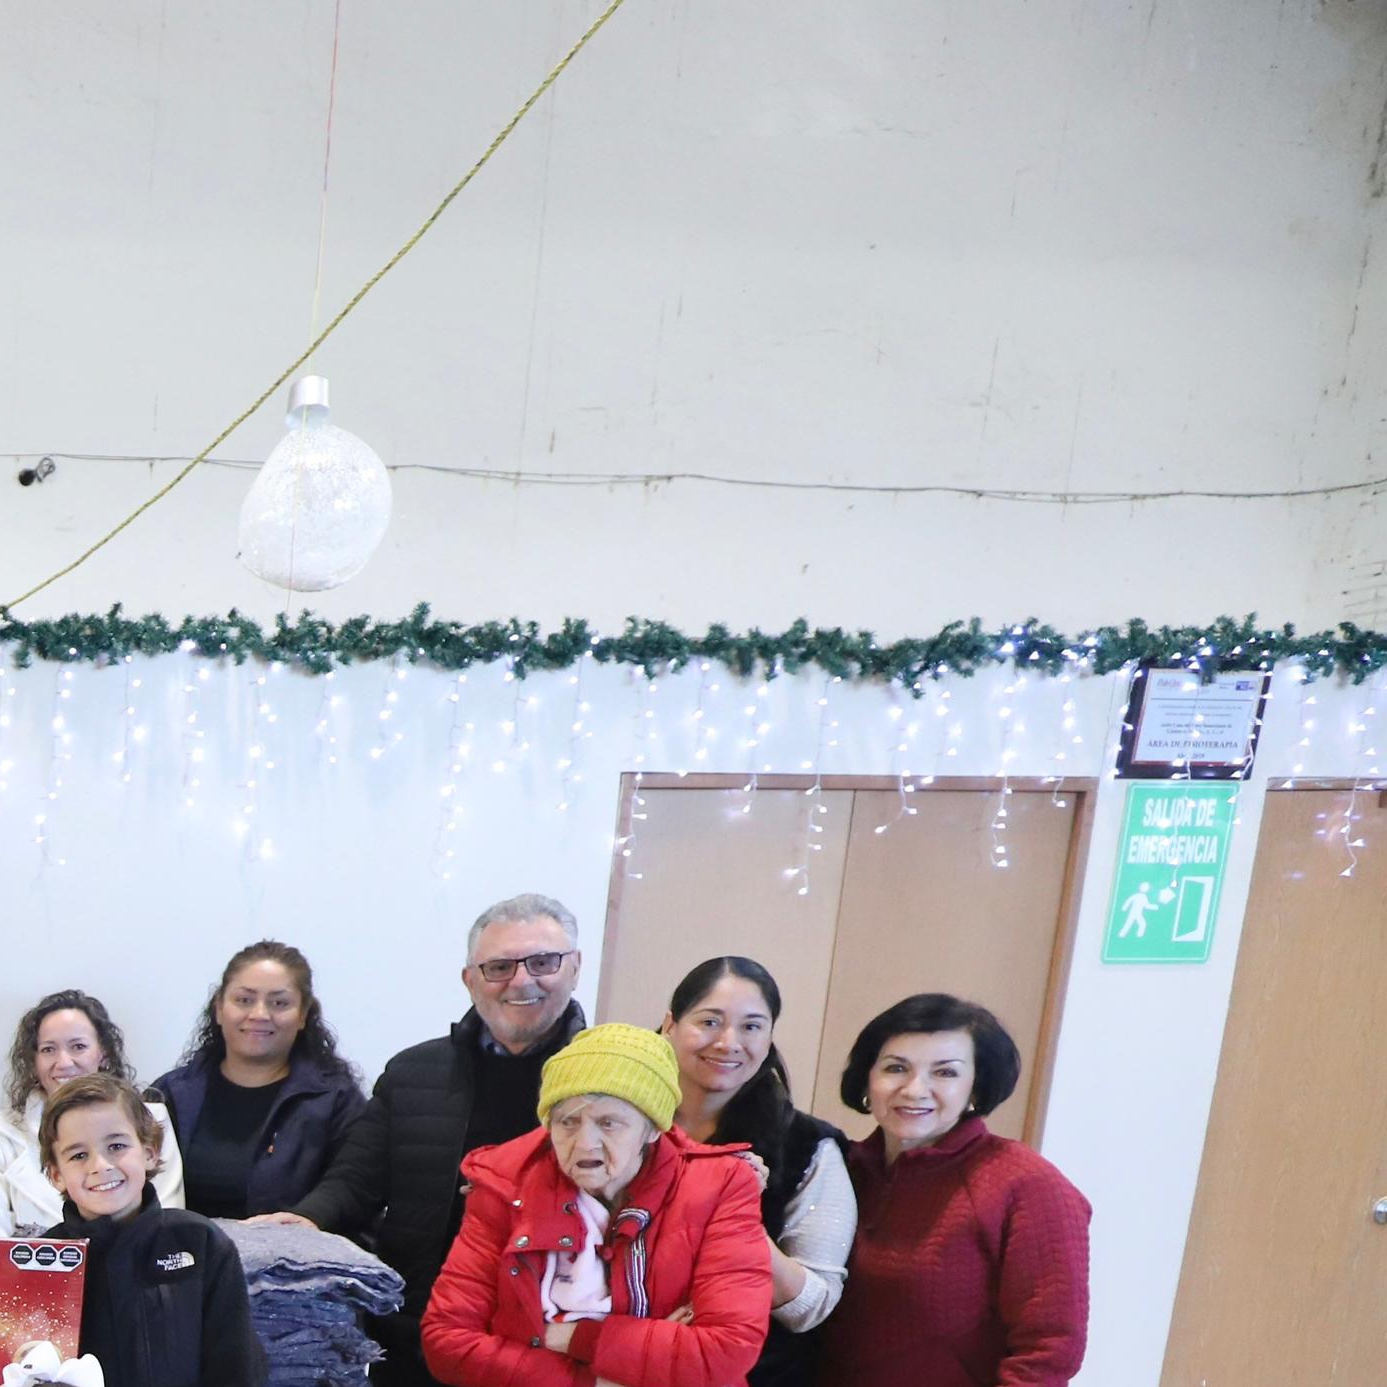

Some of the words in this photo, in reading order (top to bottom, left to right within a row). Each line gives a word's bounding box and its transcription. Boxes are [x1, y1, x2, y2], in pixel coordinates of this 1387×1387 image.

[1142, 797, 1194, 827] SALIDA
[1196, 798, 1218, 827] DE
[1128, 835, 1218, 864] EMERGENCIA
